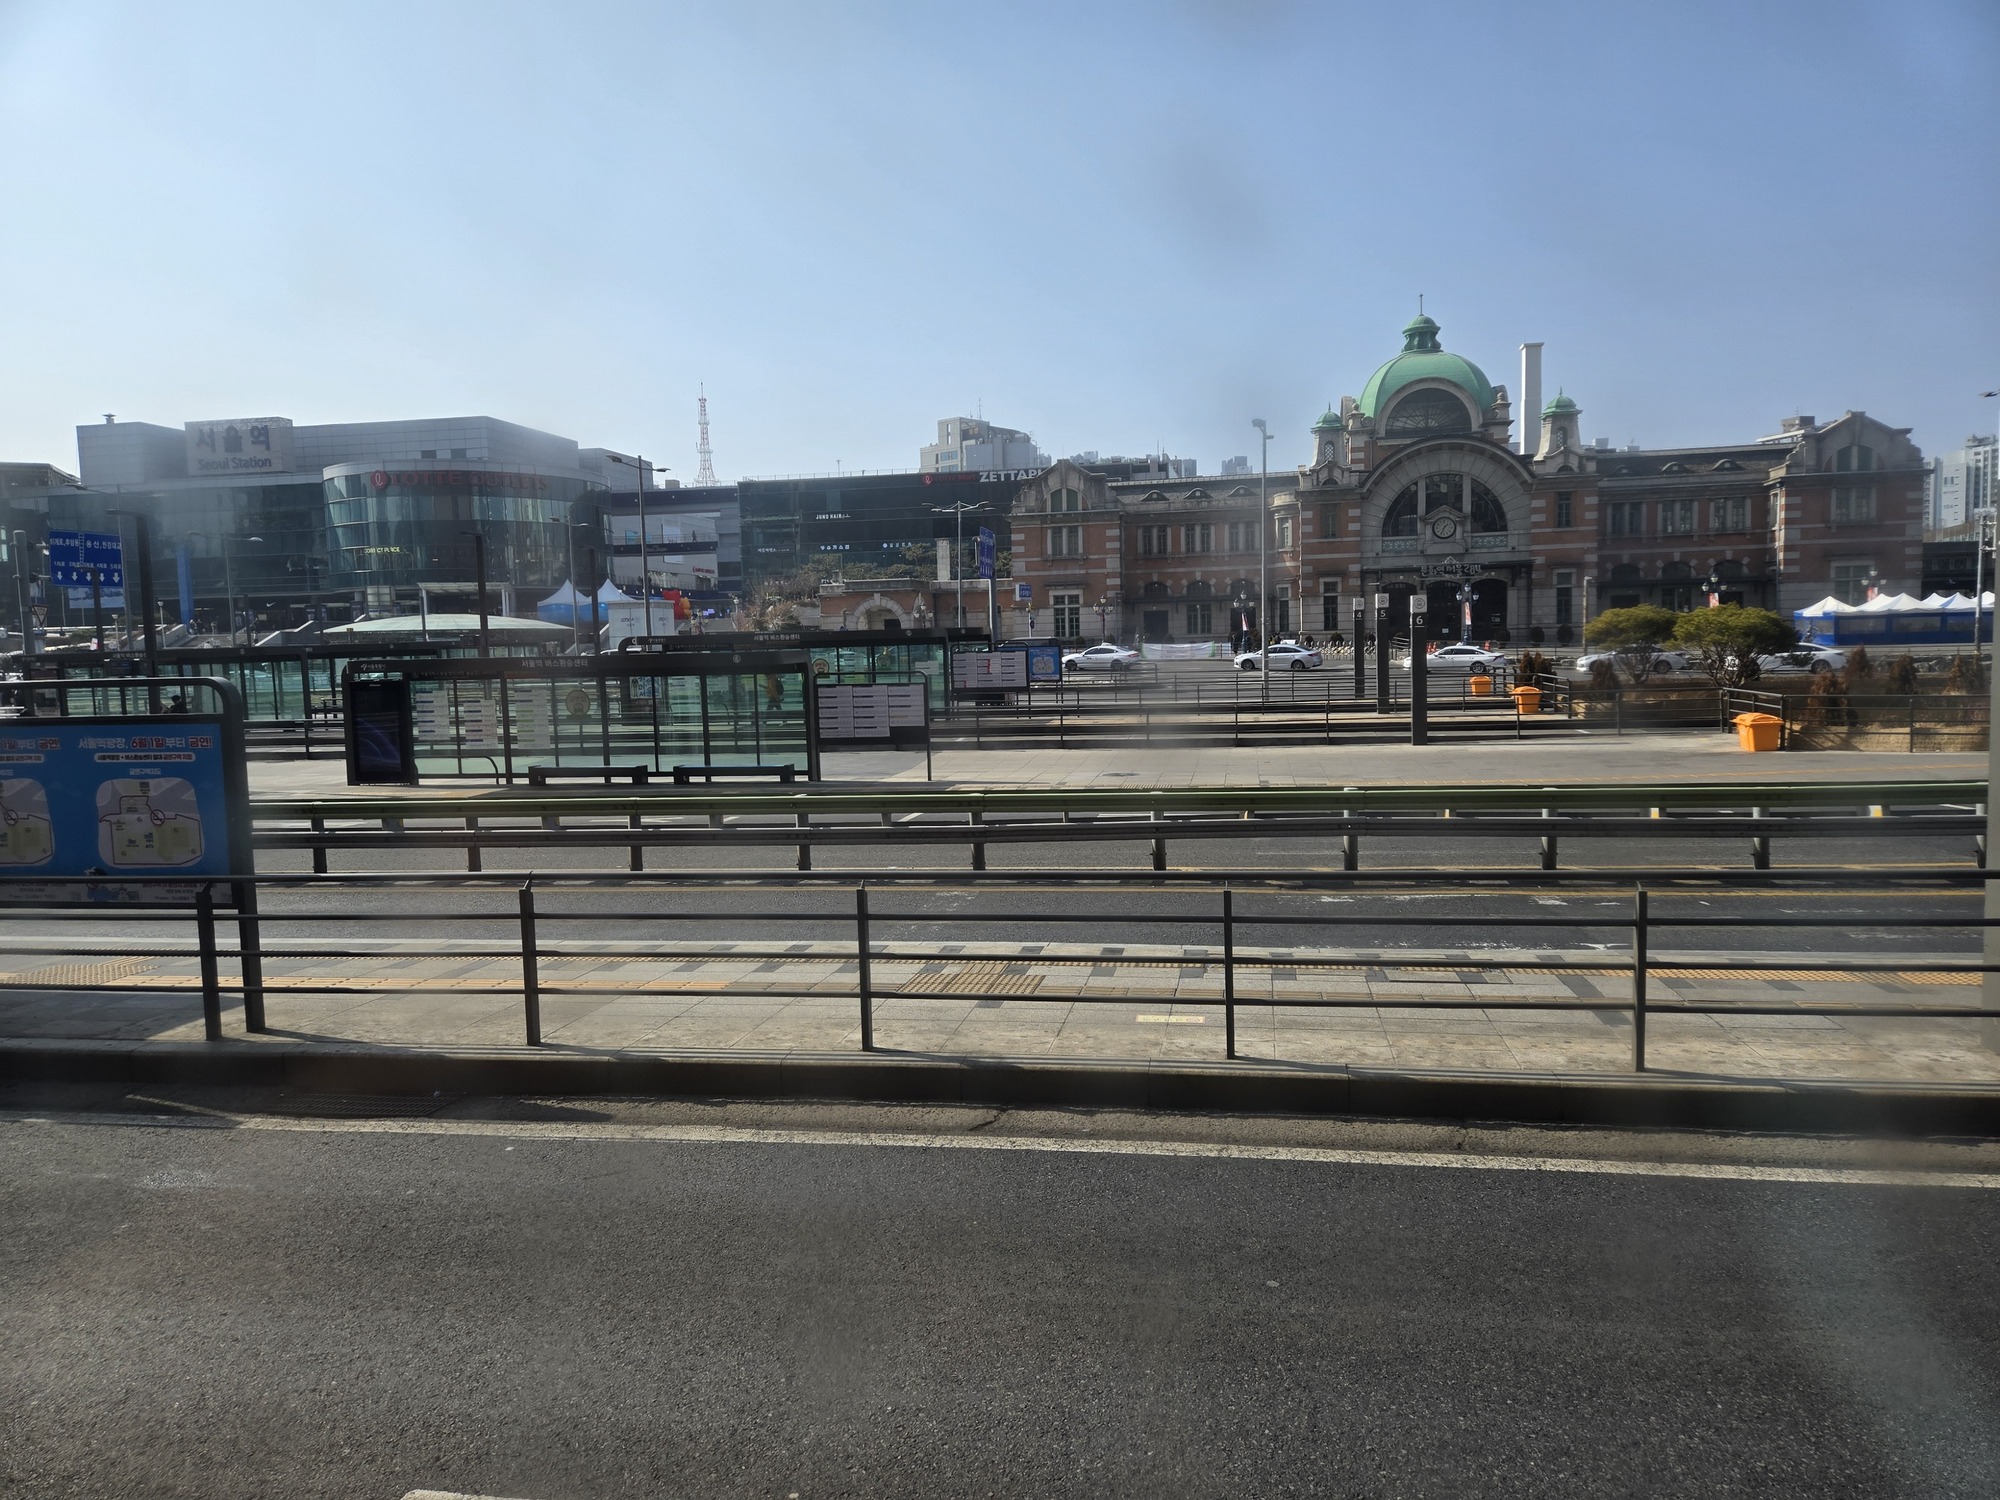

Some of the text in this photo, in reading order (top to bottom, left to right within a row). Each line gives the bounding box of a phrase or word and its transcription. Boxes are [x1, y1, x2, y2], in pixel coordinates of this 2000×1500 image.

[196, 424, 271, 454] 서울역
[198, 456, 272, 471] Seoul Station
[391, 472, 463, 486] LOTTE
[1380, 610, 1386, 618] 5
[1416, 615, 1423, 625] 6
[770, 633, 800, 641] 버스환승센터
[522, 658, 588, 668] 서울역 버스환승센터
[78, 737, 128, 750] 서울역광장,
[188, 736, 213, 749] 금연!
